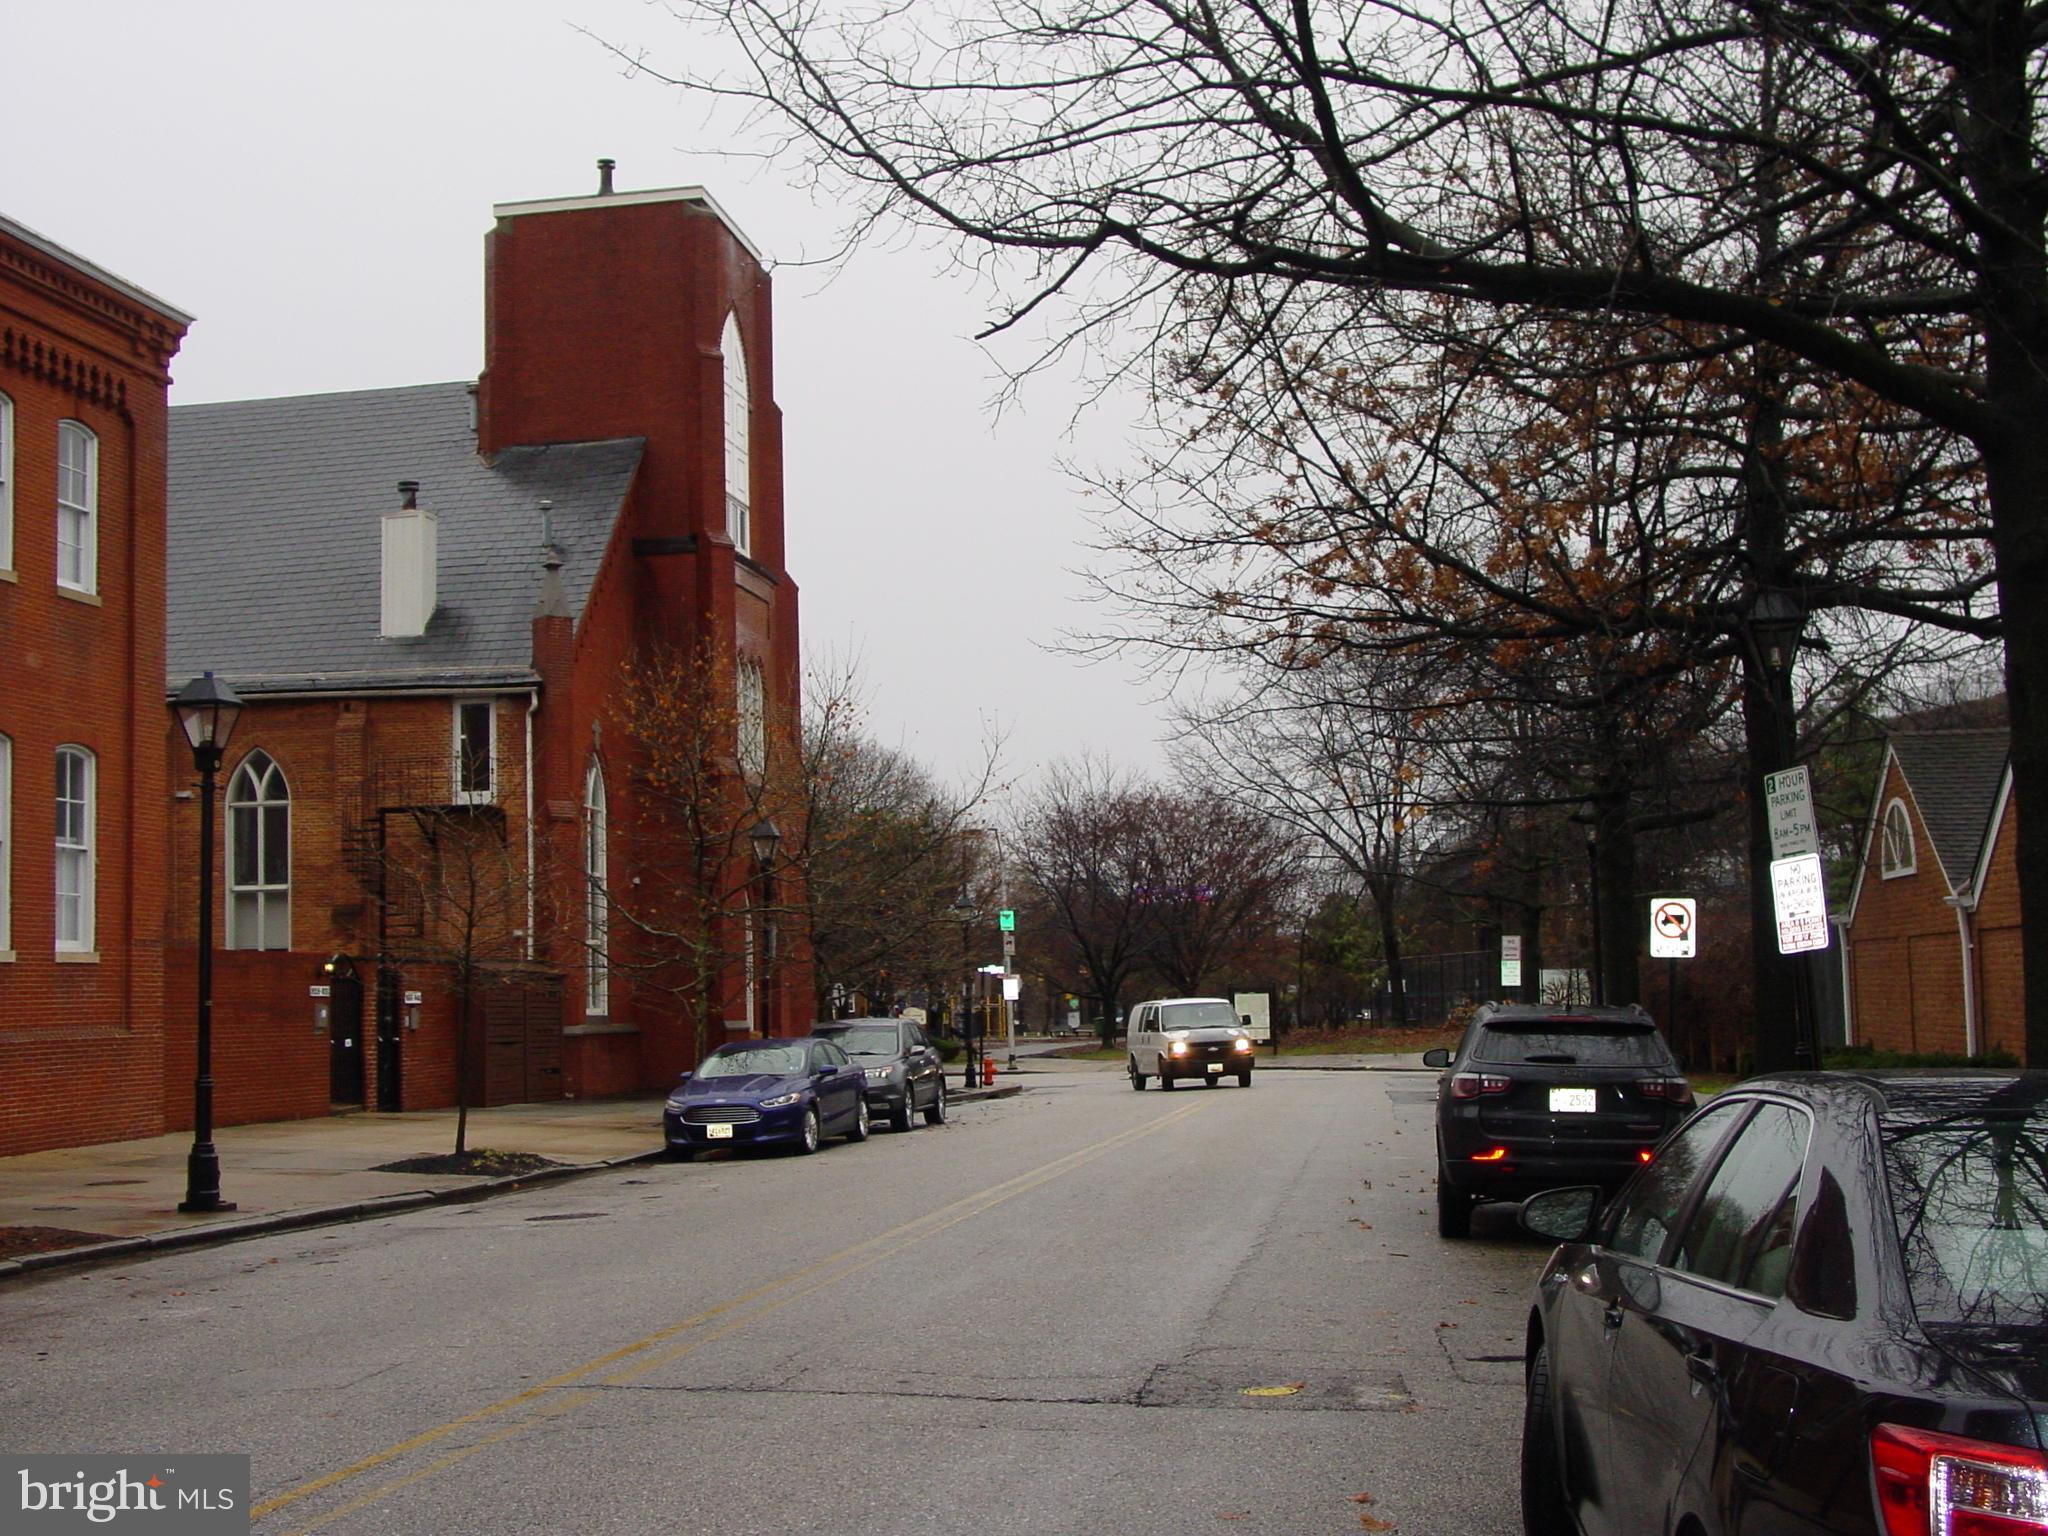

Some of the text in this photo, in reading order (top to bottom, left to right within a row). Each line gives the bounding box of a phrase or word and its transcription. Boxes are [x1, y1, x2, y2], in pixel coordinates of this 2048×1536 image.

[1767, 772, 1805, 793] 2 HOUR
[1771, 789, 1805, 807] PARKING
[1780, 808, 1797, 820] LIMIT
[1778, 873, 1816, 888] PARKING
